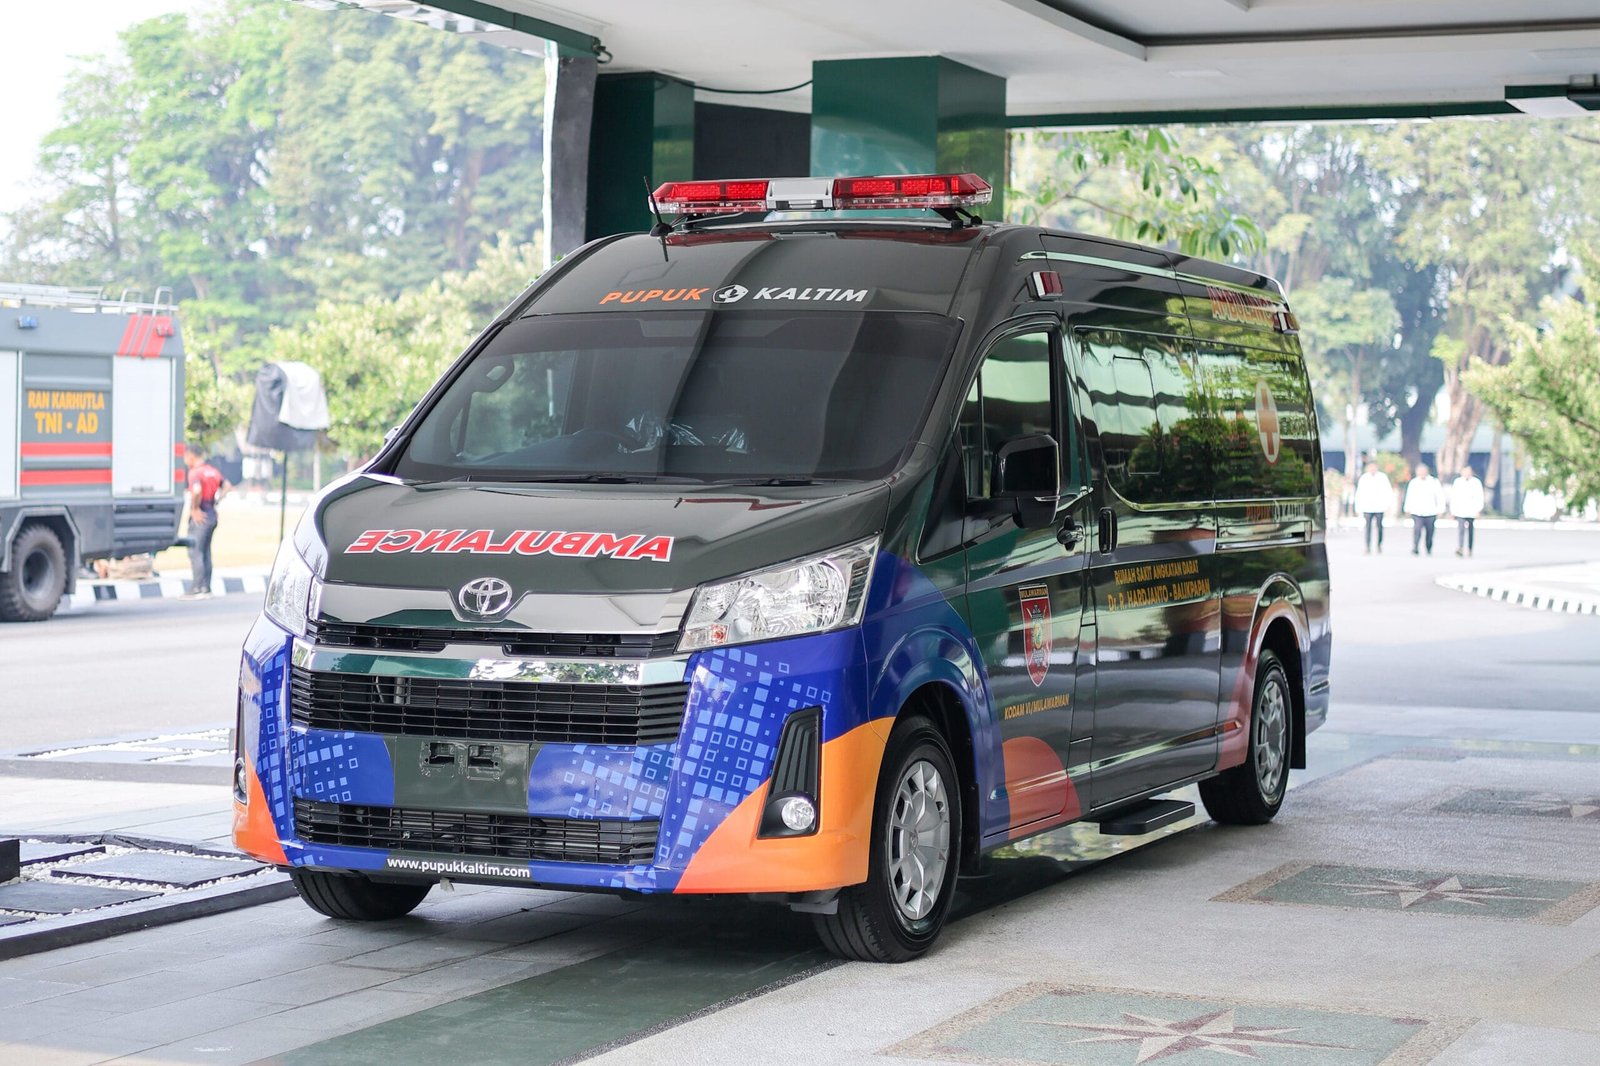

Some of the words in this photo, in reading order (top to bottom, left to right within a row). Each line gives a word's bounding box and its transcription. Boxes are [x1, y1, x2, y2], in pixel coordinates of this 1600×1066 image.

[599, 287, 710, 304] PUPUK
[753, 287, 868, 302] KALTIM
[28, 390, 49, 409] RAN
[51, 390, 105, 410] KARHUTLA
[34, 411, 63, 434] TNI
[76, 411, 98, 434] AD
[1114, 568, 1136, 585] RUMAH
[1137, 565, 1152, 582] SAKIT
[1153, 561, 1181, 579] ANGKATAN
[1182, 560, 1199, 574] DARAT
[1127, 585, 1168, 608] HARDJANTO
[1173, 578, 1211, 600] BALIKPAPAN
[1004, 703, 1025, 720] KODAM
[387, 858, 530, 878] www.pupukkaltim.com
